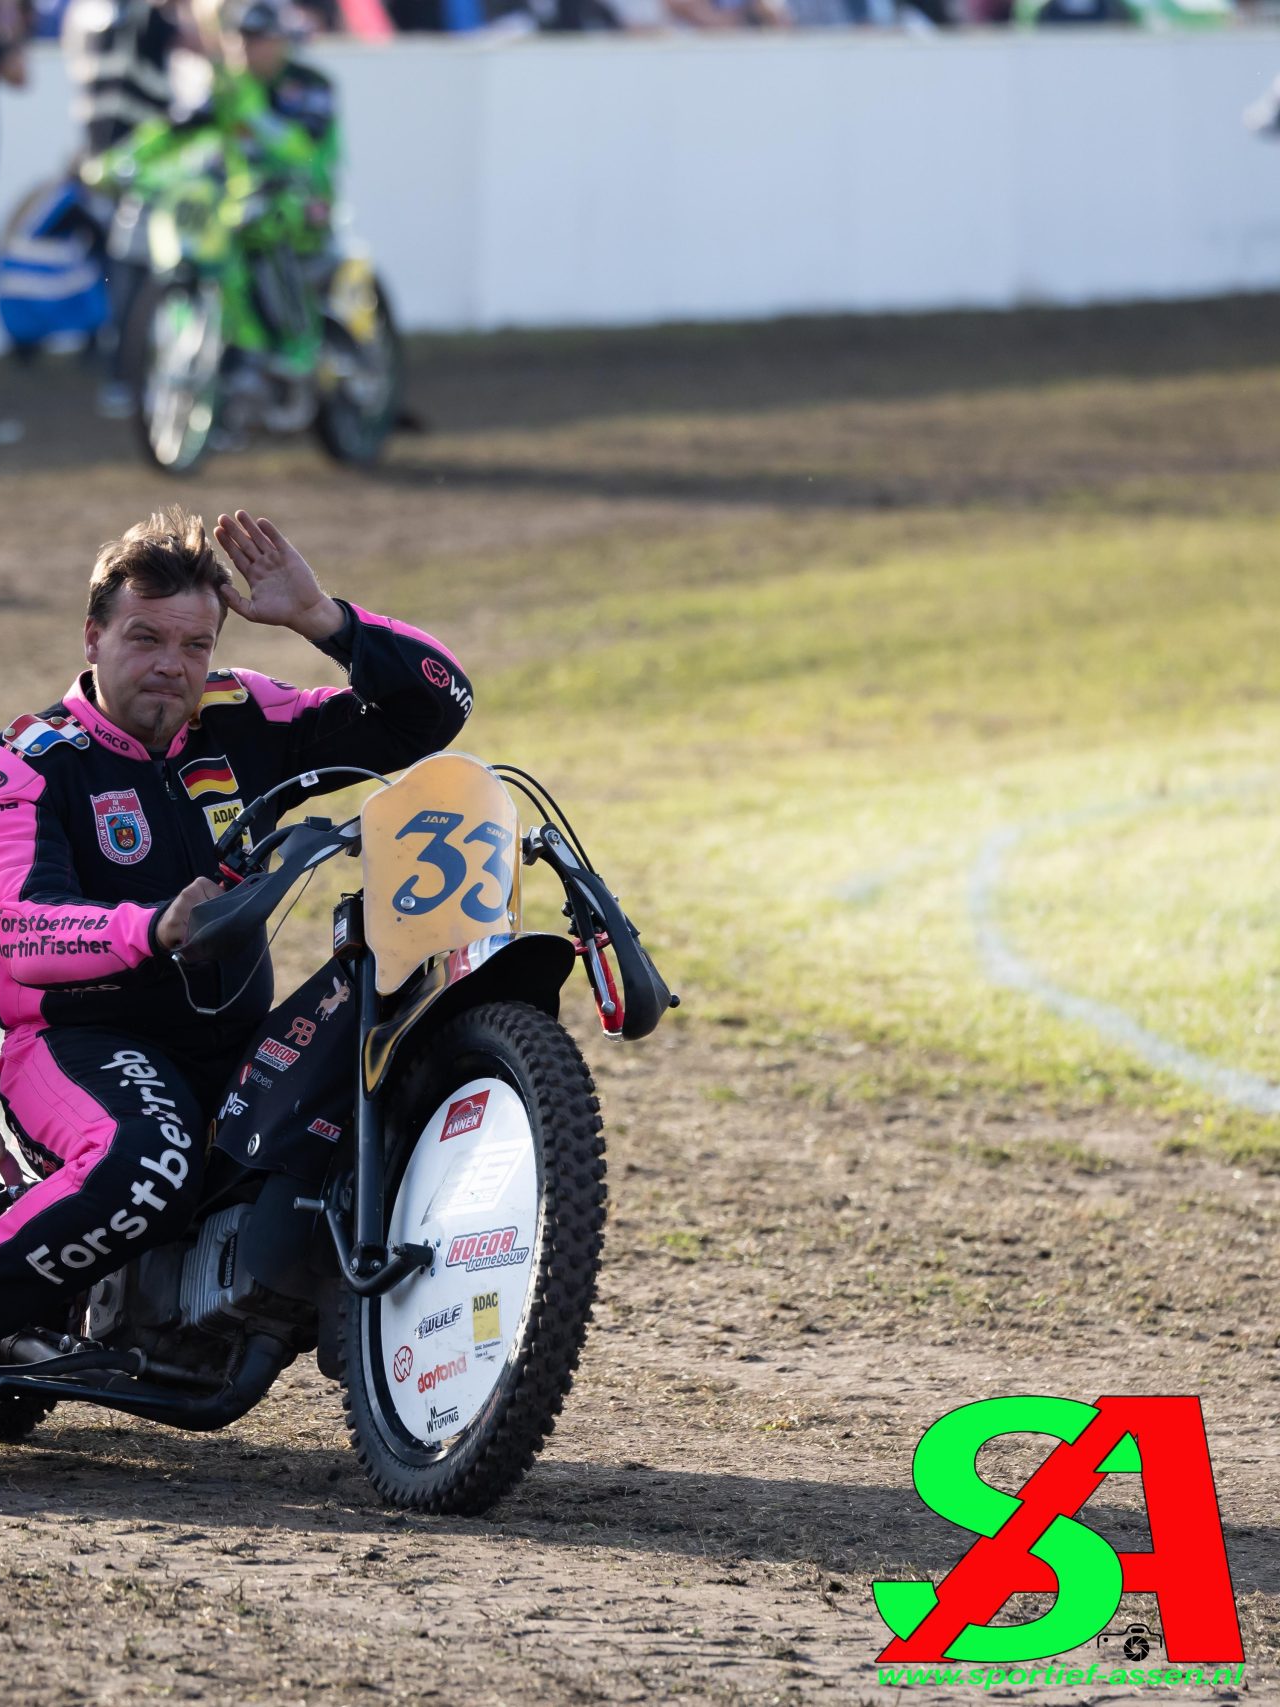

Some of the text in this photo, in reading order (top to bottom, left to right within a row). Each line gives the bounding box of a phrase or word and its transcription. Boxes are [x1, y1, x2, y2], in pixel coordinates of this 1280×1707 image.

[94, 723, 130, 751] WACO
[108, 805, 126, 813] ADAC
[213, 806, 240, 825] ADAC
[422, 815, 450, 824] JAN
[100, 829, 133, 863] MOTORSPORT
[392, 810, 513, 923] 33
[260, 1039, 299, 1065] HOCOB
[445, 1113, 480, 1137] ANNEN
[25, 1049, 192, 1286] Forstbetrieb
[448, 1231, 515, 1263] HOCOB
[466, 1249, 528, 1270] framebouw
[473, 1292, 498, 1313] ADAC
[425, 1307, 461, 1334] WULF
[417, 1352, 467, 1394] daytona
